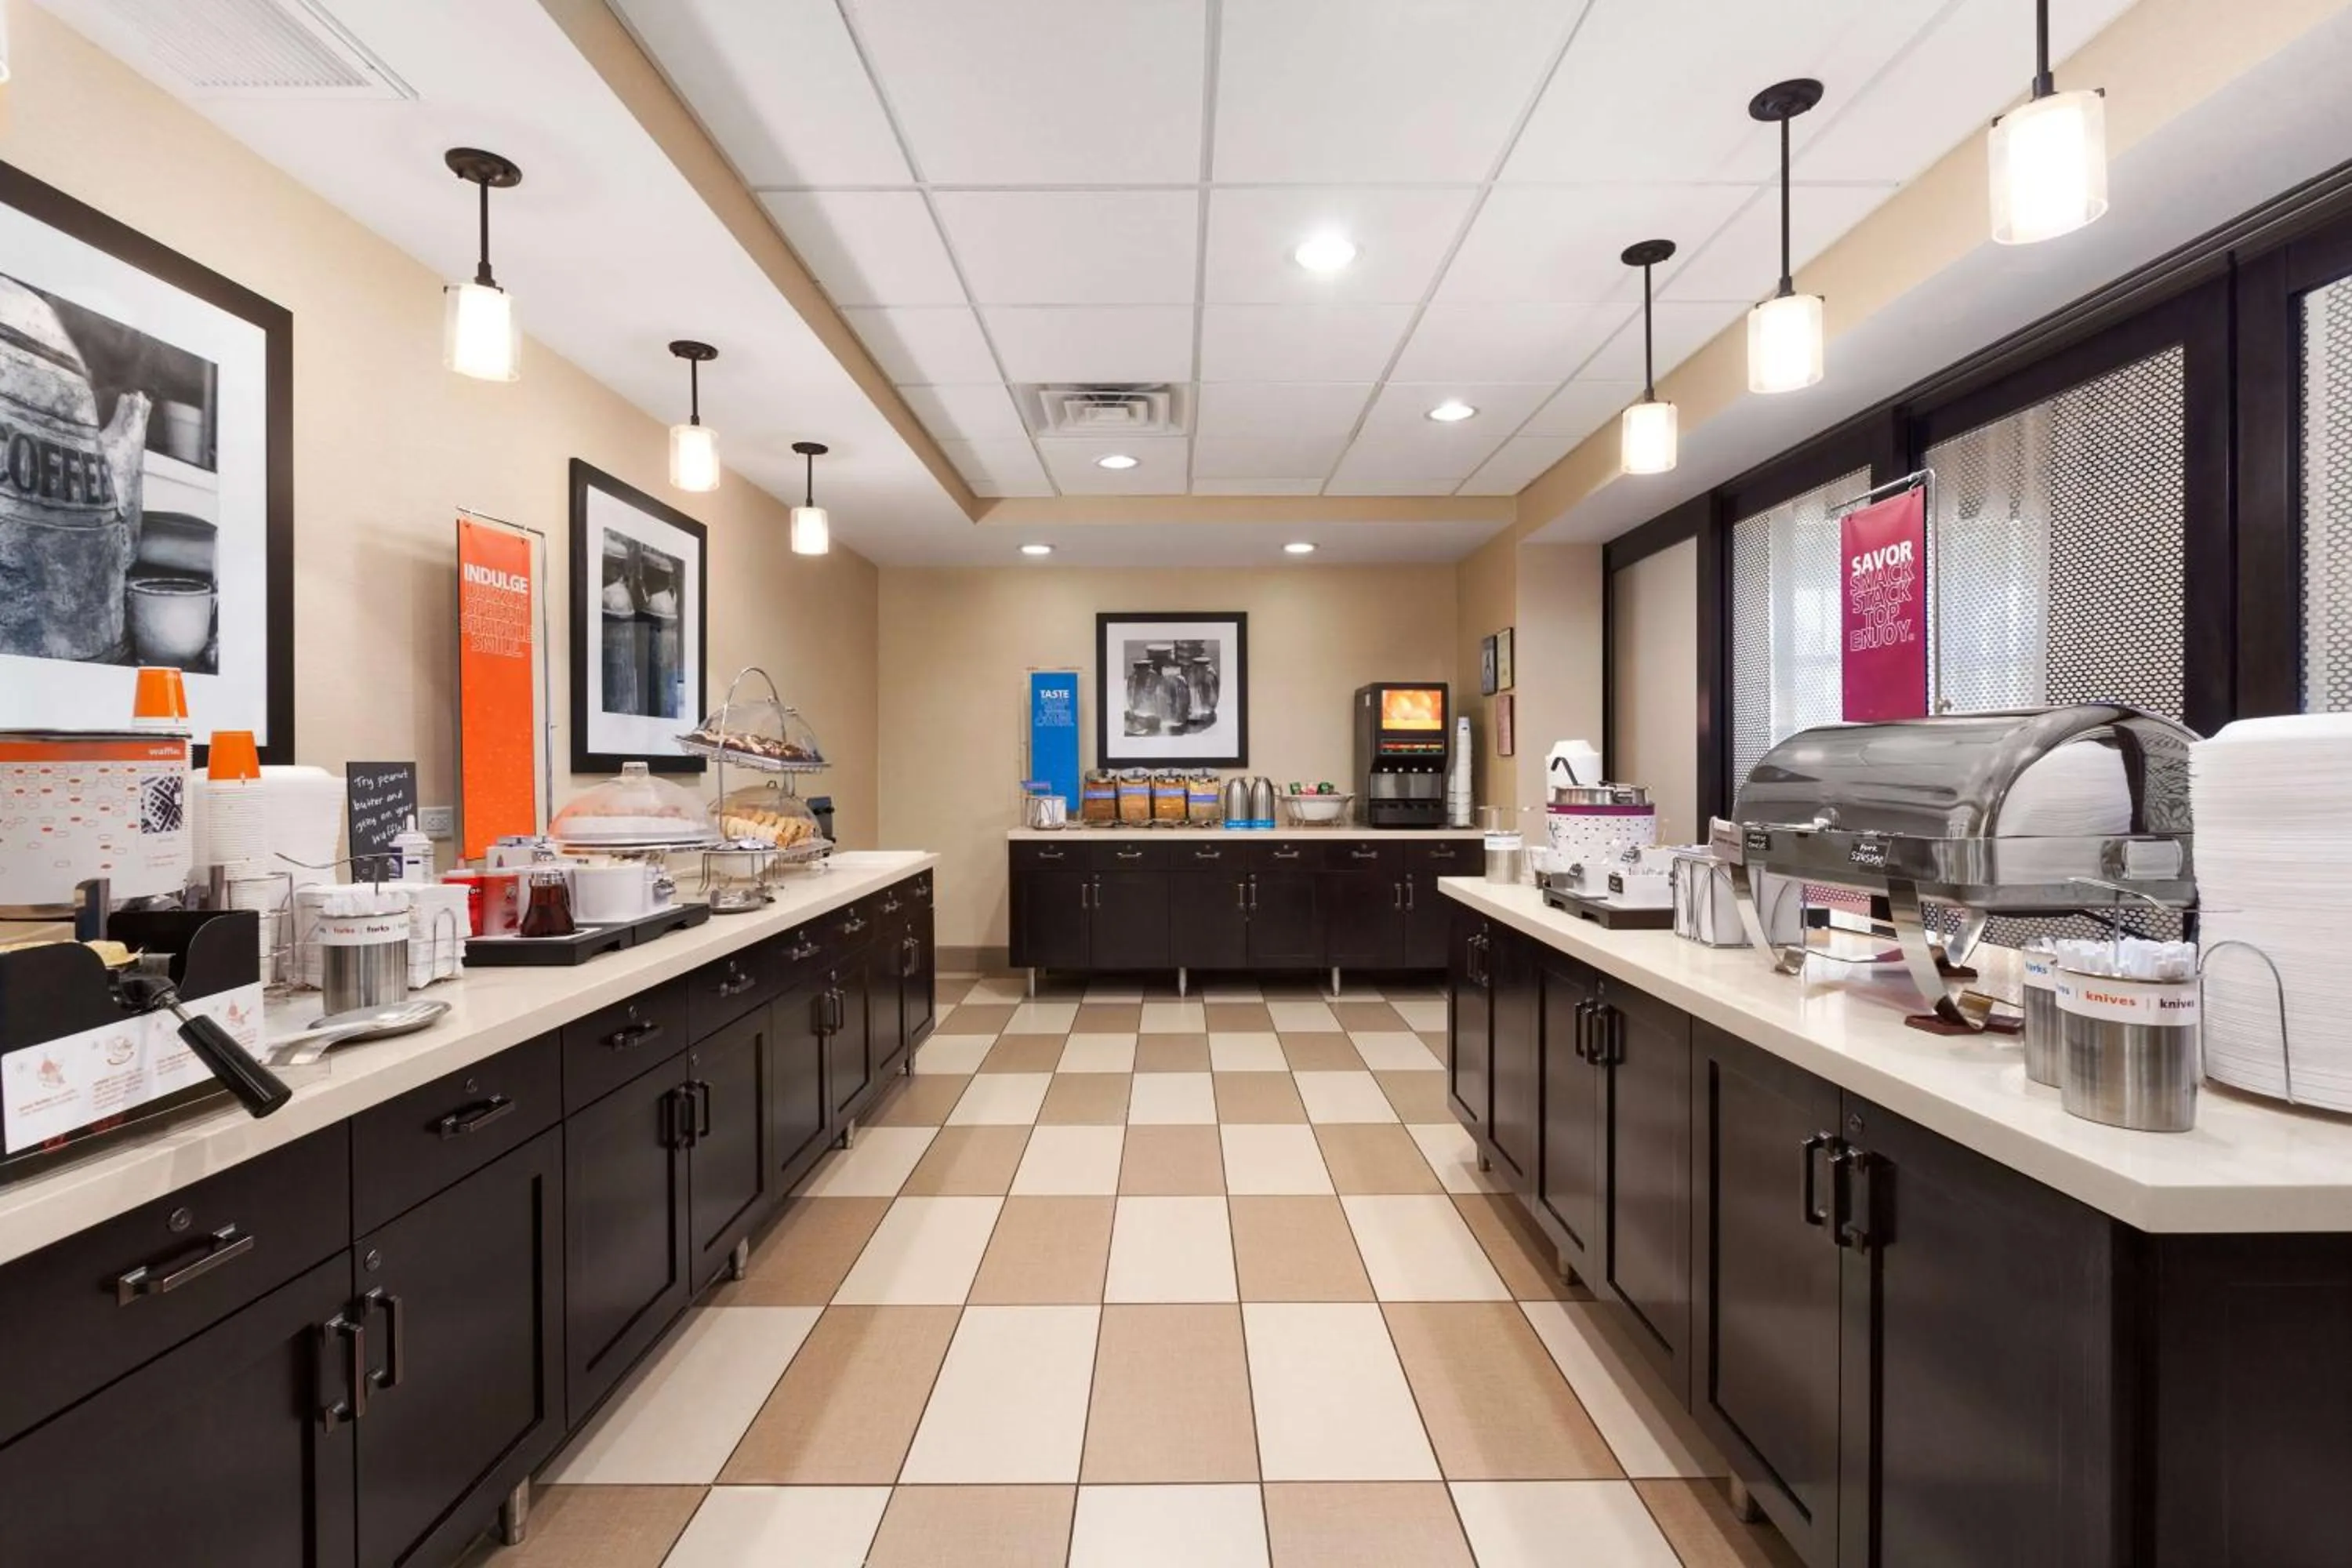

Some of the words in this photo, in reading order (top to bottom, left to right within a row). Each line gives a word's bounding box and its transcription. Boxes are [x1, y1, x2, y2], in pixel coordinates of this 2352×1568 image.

[1852, 540, 1913, 577] SAVOR
[464, 563, 528, 593] INDULGE
[1850, 557, 1915, 596] SNACK
[1853, 580, 1912, 614] STACK
[1863, 602, 1900, 629] TOP
[1040, 689, 1069, 698] TASTE
[354, 775, 374, 790] Try
[377, 768, 408, 787] peanut
[353, 797, 383, 811] butter
[387, 789, 402, 802] and
[2086, 990, 2136, 1007] knives
